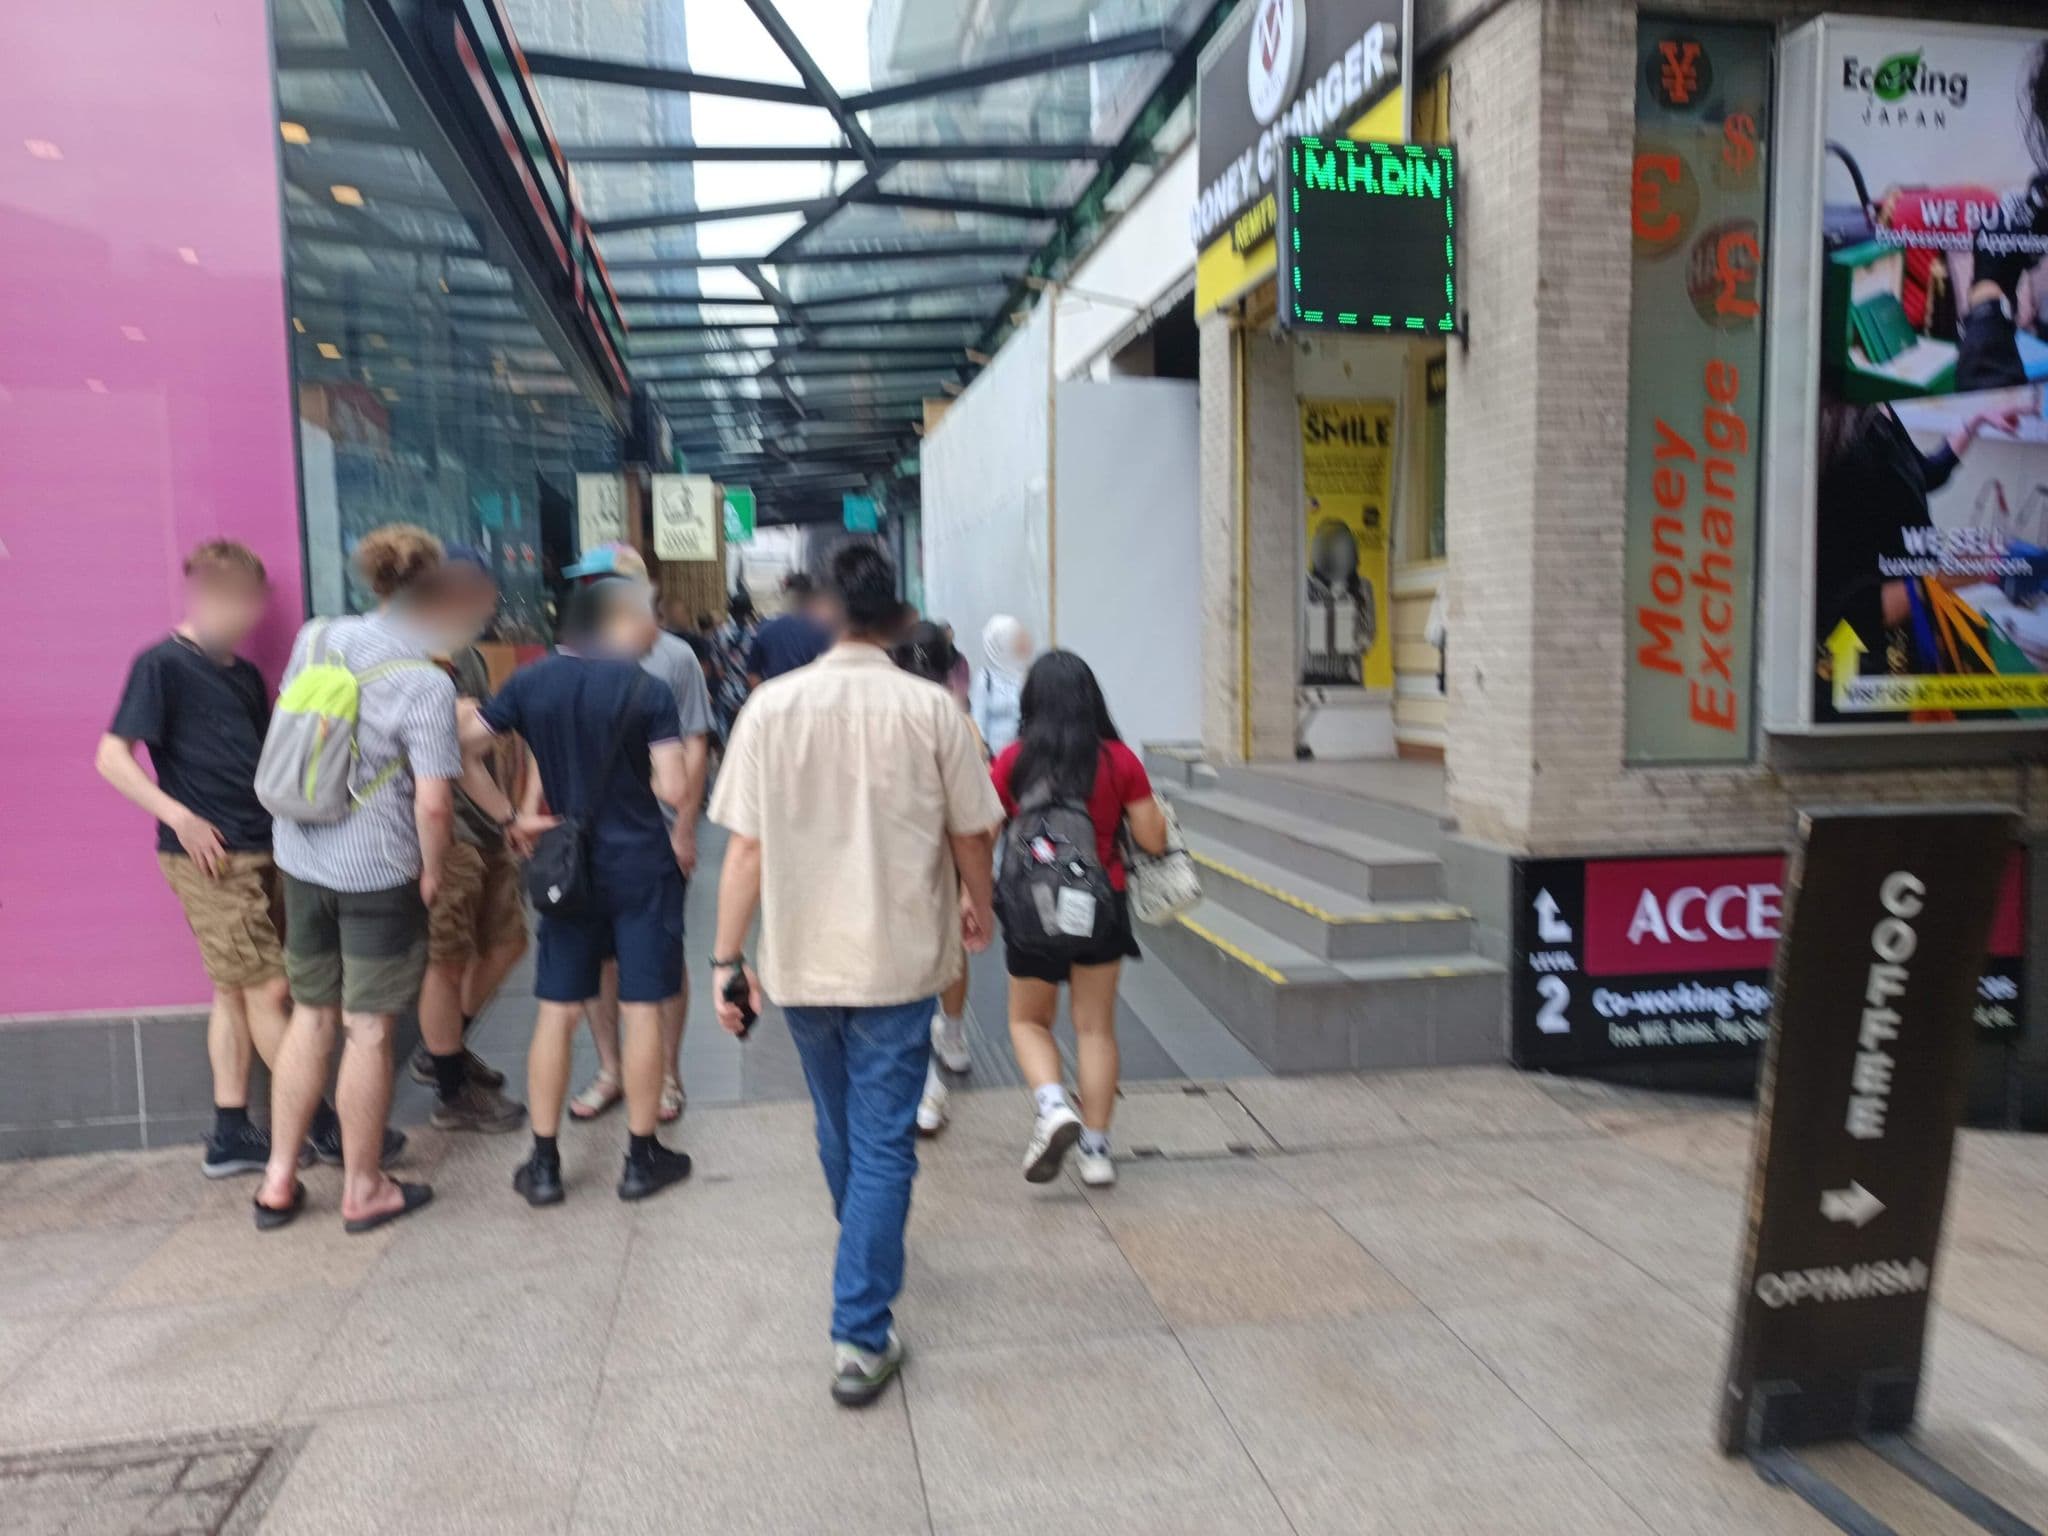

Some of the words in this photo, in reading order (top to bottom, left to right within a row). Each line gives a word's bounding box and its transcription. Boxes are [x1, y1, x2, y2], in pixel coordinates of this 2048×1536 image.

[1861, 106, 1946, 128] JAPAN
[1920, 198, 1959, 229] WE
[1965, 199, 2012, 232] BUY
[1306, 415, 1391, 448] SMILE
[1636, 417, 1698, 677] Money
[1688, 357, 1749, 734] Exchange
[1901, 526, 1941, 556] WE
[1535, 973, 1571, 1034] 2
[1592, 981, 1736, 1019] Co-working
[1845, 870, 1927, 1139] COFFEE
[1755, 1256, 1929, 1309] OPTIMISM
